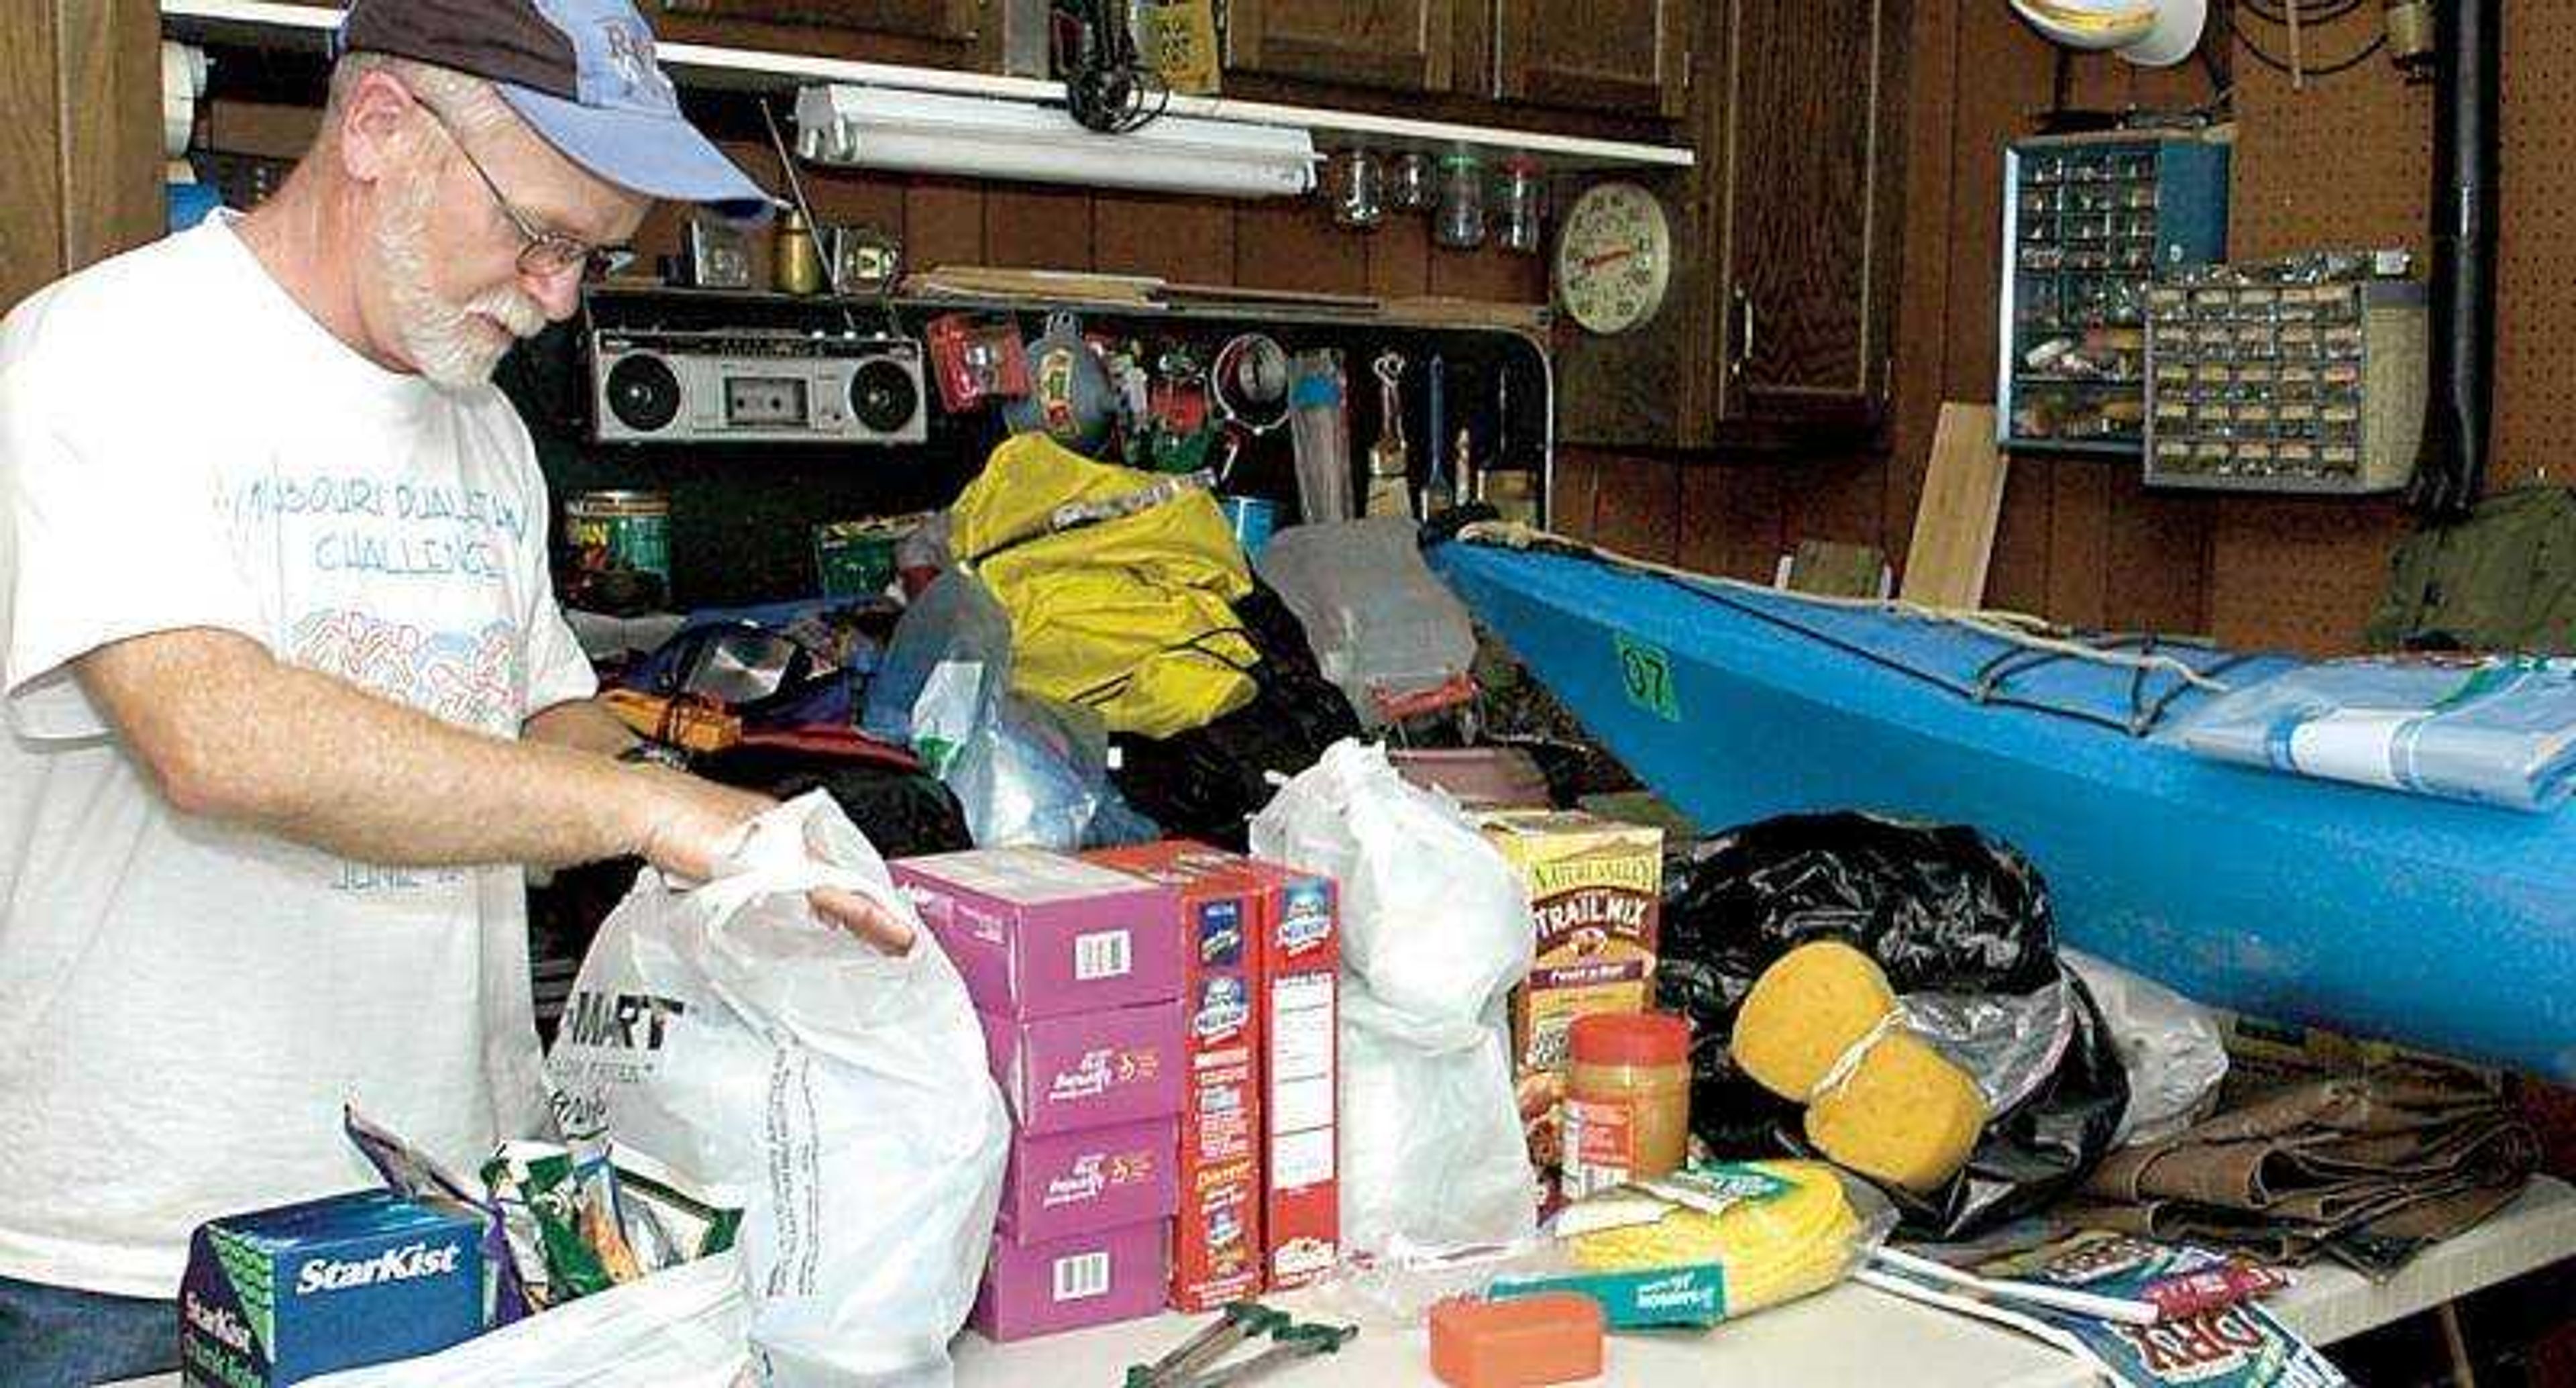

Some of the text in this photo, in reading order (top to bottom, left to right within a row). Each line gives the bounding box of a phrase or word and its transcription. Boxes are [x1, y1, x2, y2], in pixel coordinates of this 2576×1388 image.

[1622, 649, 1664, 706] 07
[1532, 897, 1648, 938] TRAIL MIX
[570, 992, 684, 1051] MART
[296, 1242, 462, 1294] StarKist
[186, 1290, 251, 1354] StarKist
